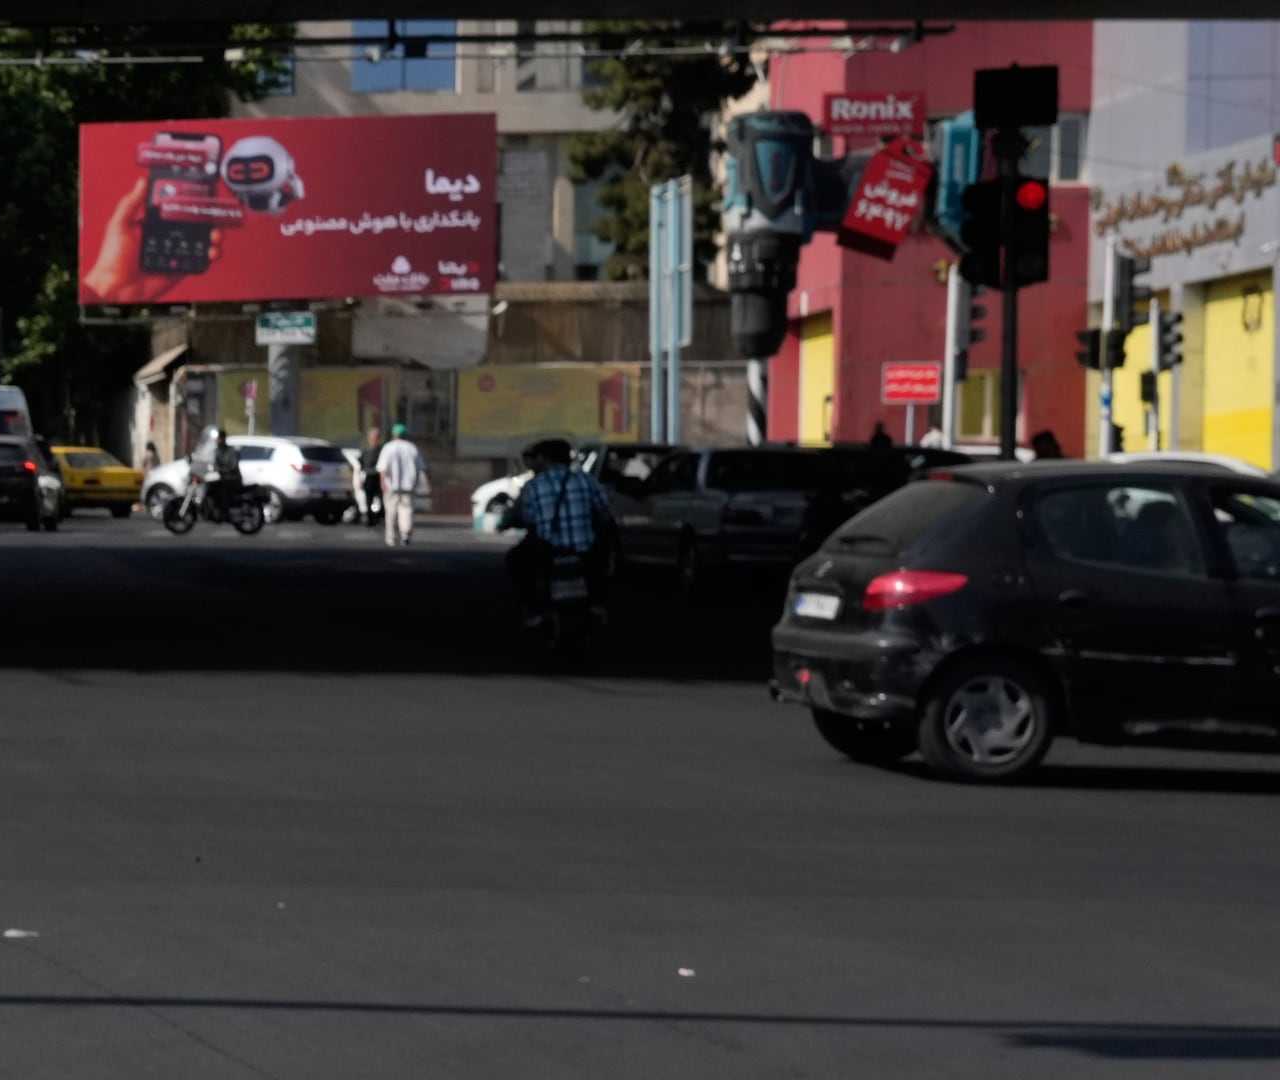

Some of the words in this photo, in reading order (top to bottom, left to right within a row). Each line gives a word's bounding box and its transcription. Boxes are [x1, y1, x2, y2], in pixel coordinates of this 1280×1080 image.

[830, 94, 912, 121] Ronix
[425, 168, 481, 202] دیما
[863, 181, 918, 208] فروش
[280, 215, 349, 236] مصنوعی
[349, 211, 398, 235] هوش
[398, 210, 413, 232] با
[413, 209, 481, 233] بانکداری
